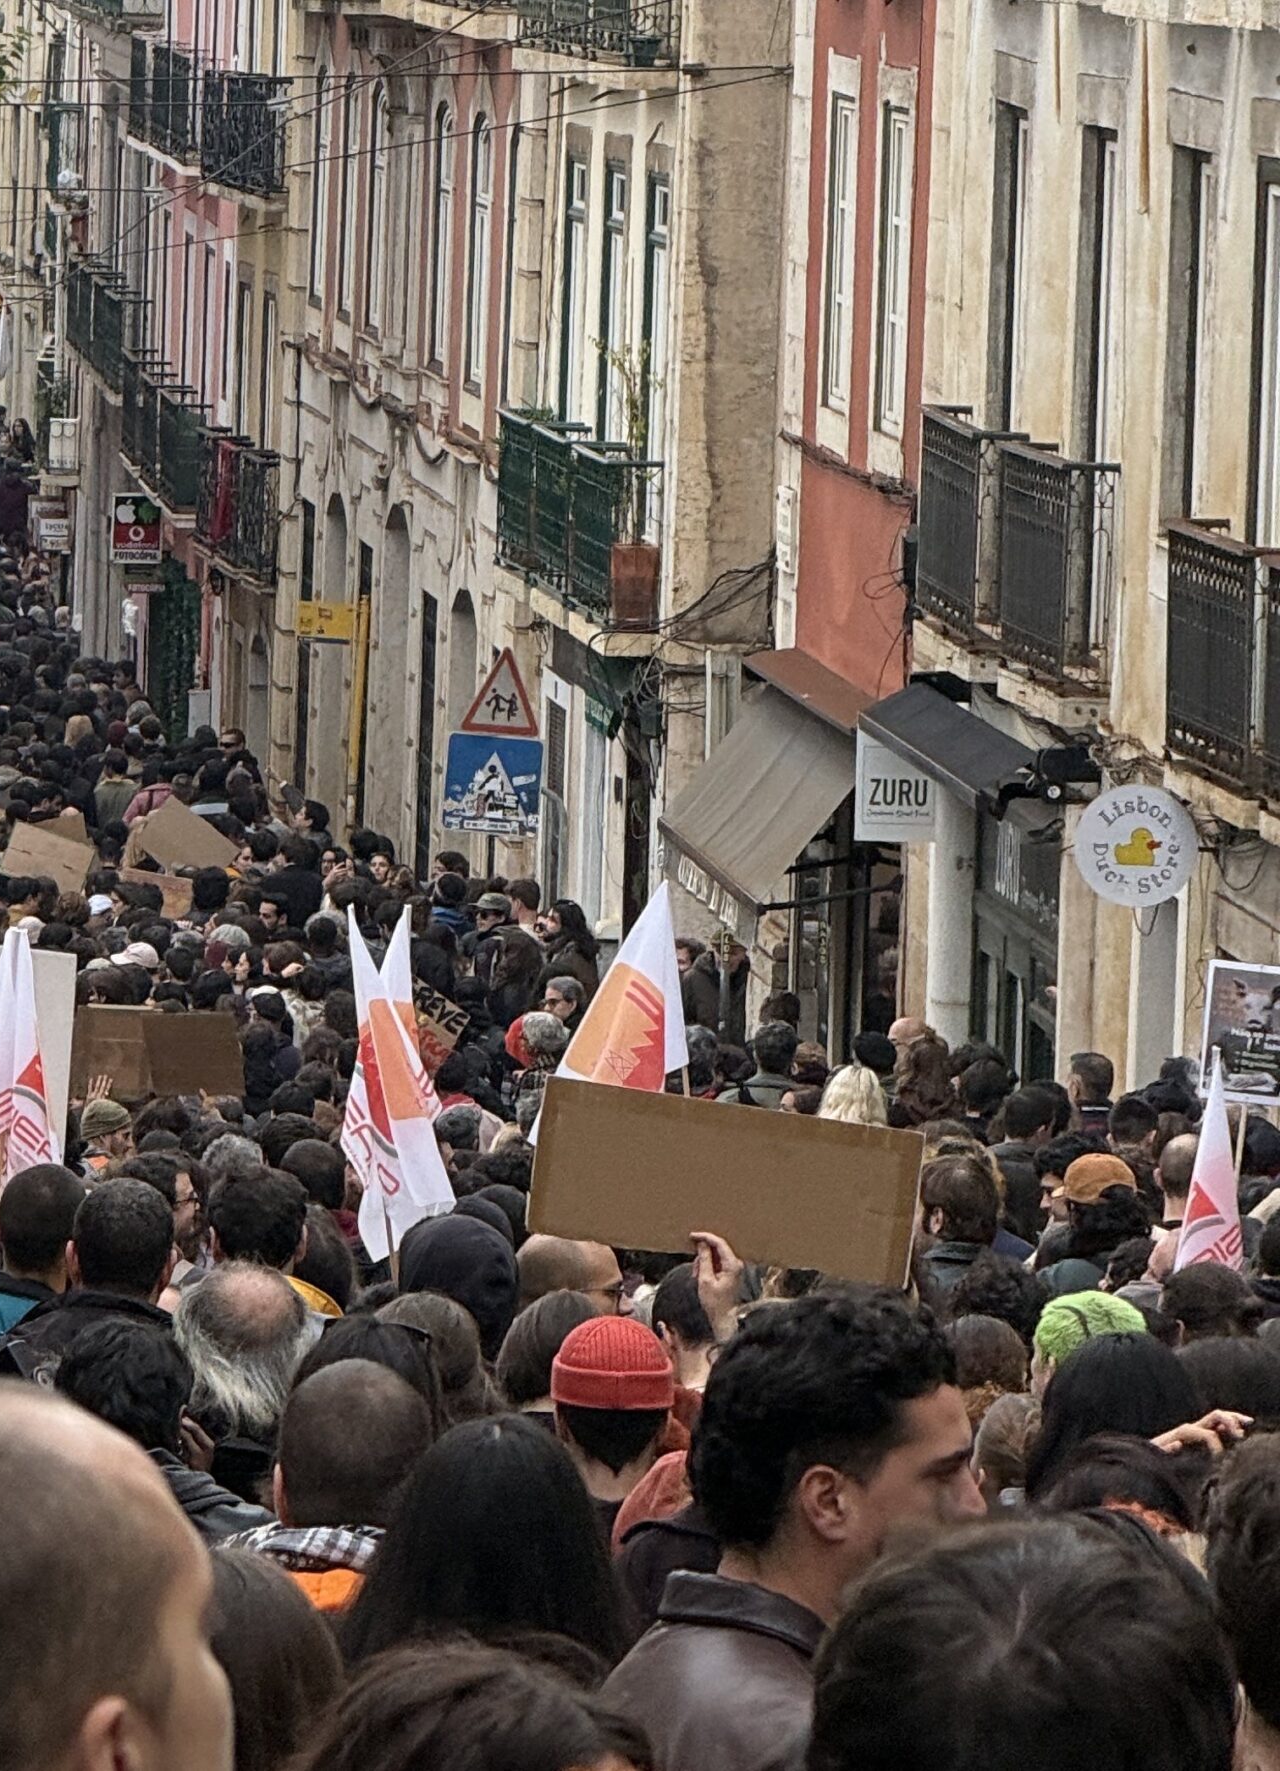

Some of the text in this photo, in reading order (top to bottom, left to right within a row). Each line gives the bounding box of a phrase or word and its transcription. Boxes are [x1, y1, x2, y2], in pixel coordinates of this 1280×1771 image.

[869, 779, 928, 807] ZURU
[1098, 795, 1172, 829] Lisbon
[1138, 844, 1180, 894] Store
